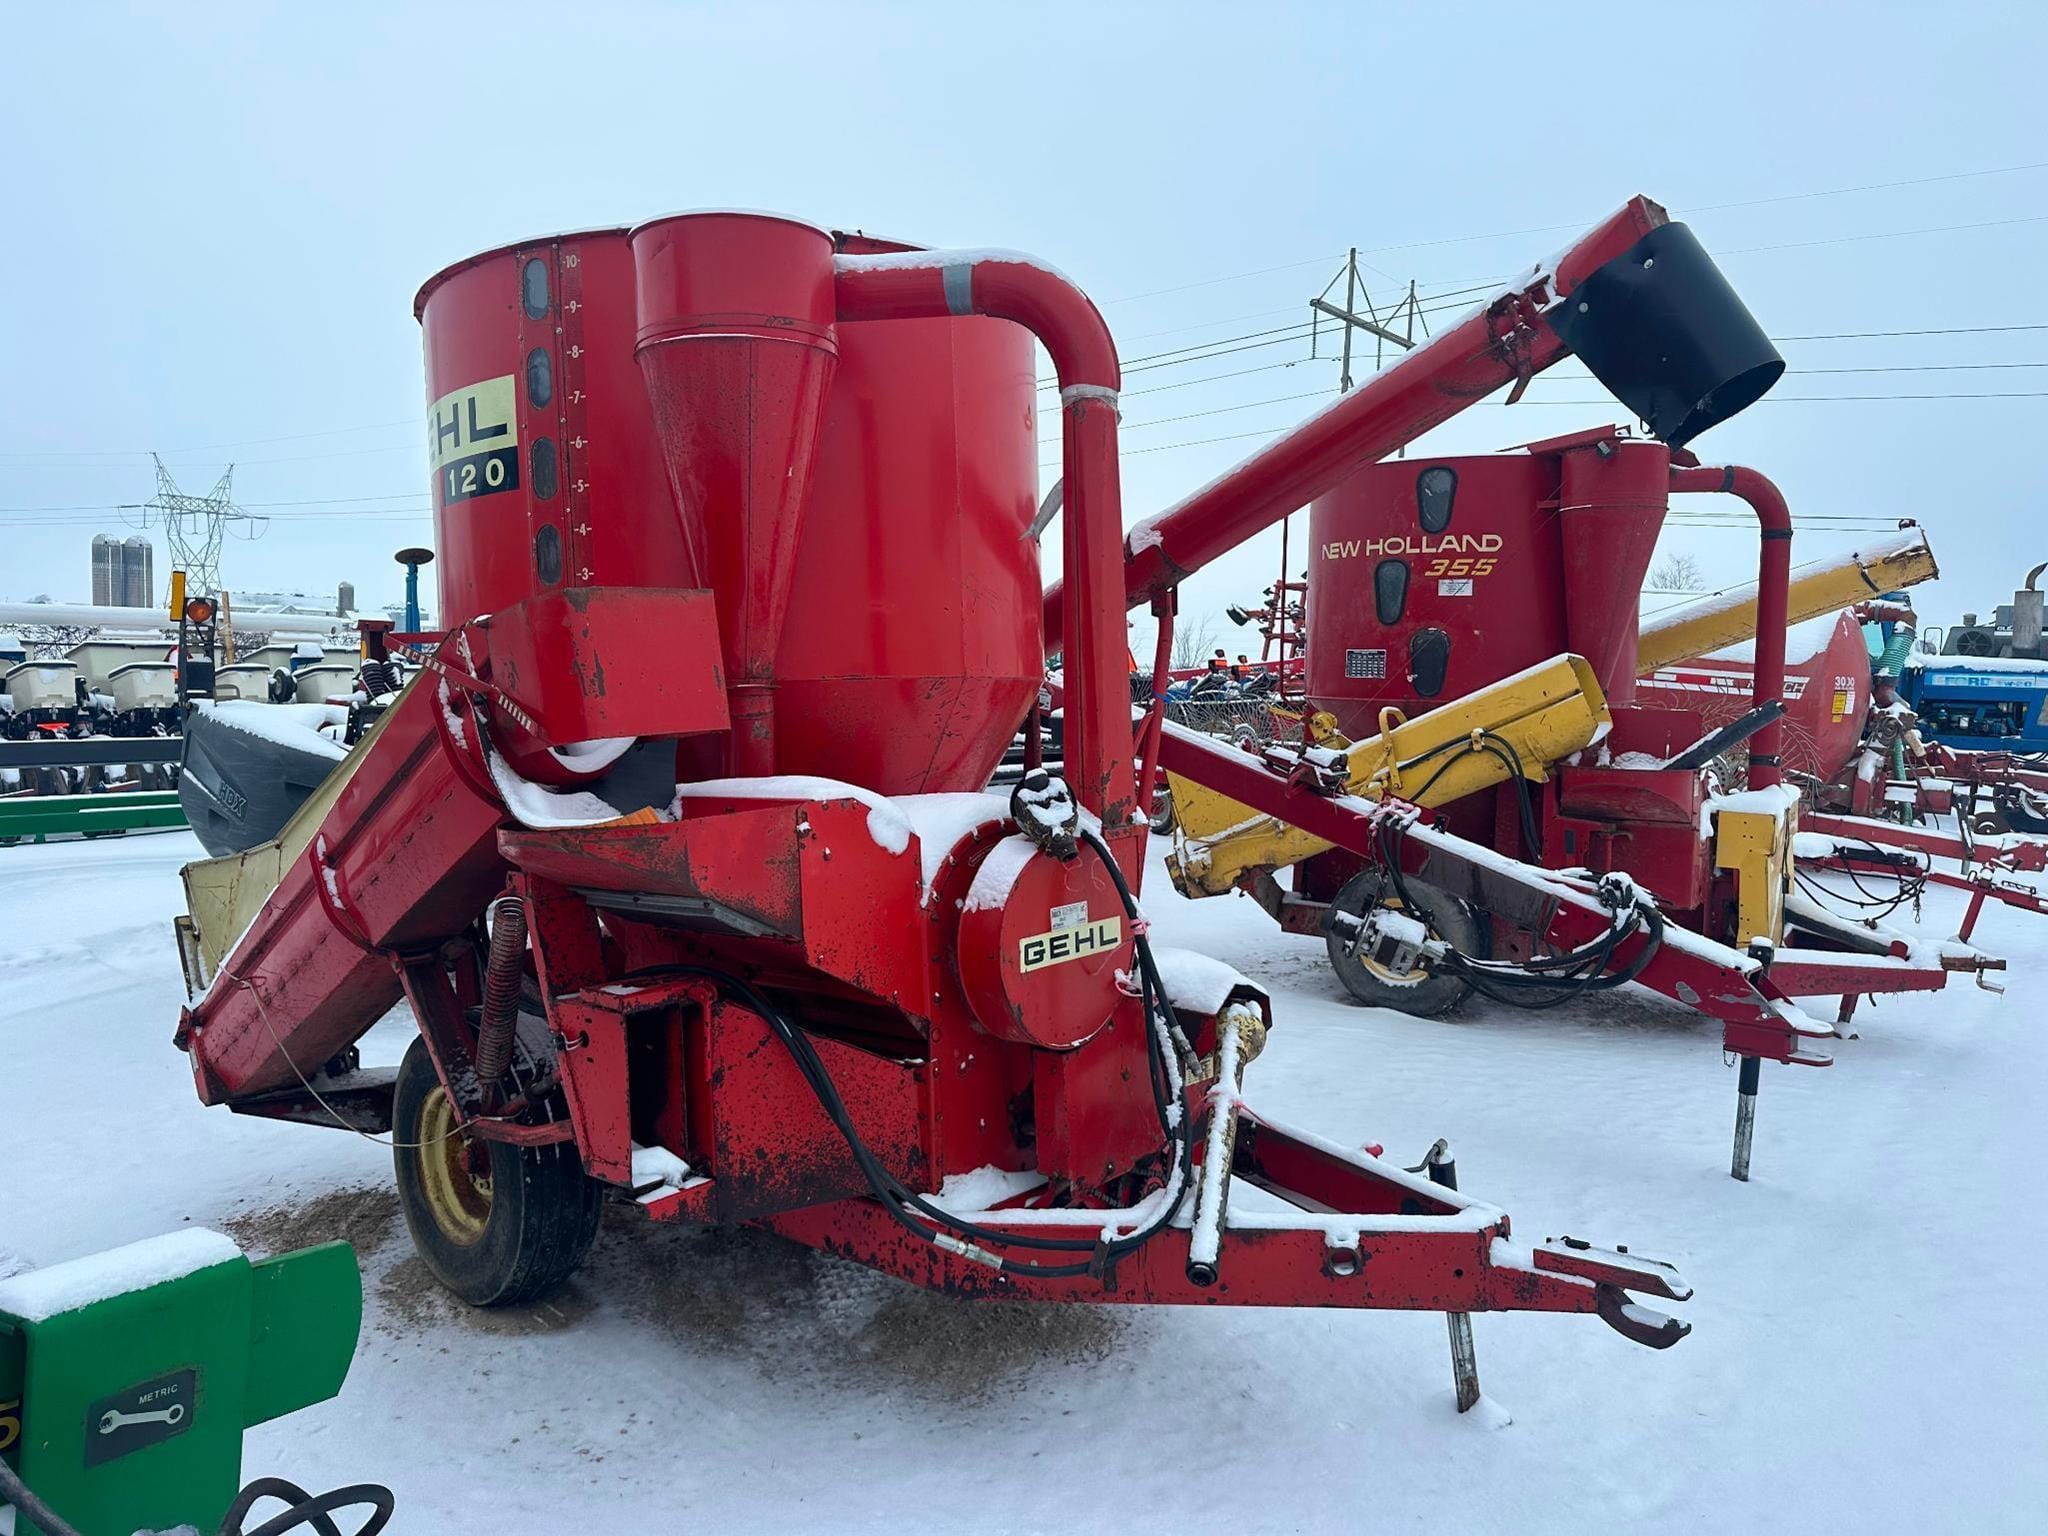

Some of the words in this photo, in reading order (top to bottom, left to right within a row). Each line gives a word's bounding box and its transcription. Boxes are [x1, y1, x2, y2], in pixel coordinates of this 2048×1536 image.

[449, 458, 505, 497] 120
[1321, 540, 1361, 561] NEW
[1366, 534, 1504, 556] HOLLAND
[1424, 558, 1498, 576] 355
[218, 780, 247, 817] HDX
[1023, 925, 1119, 966] GEHL
[138, 1383, 178, 1405] METRIC
